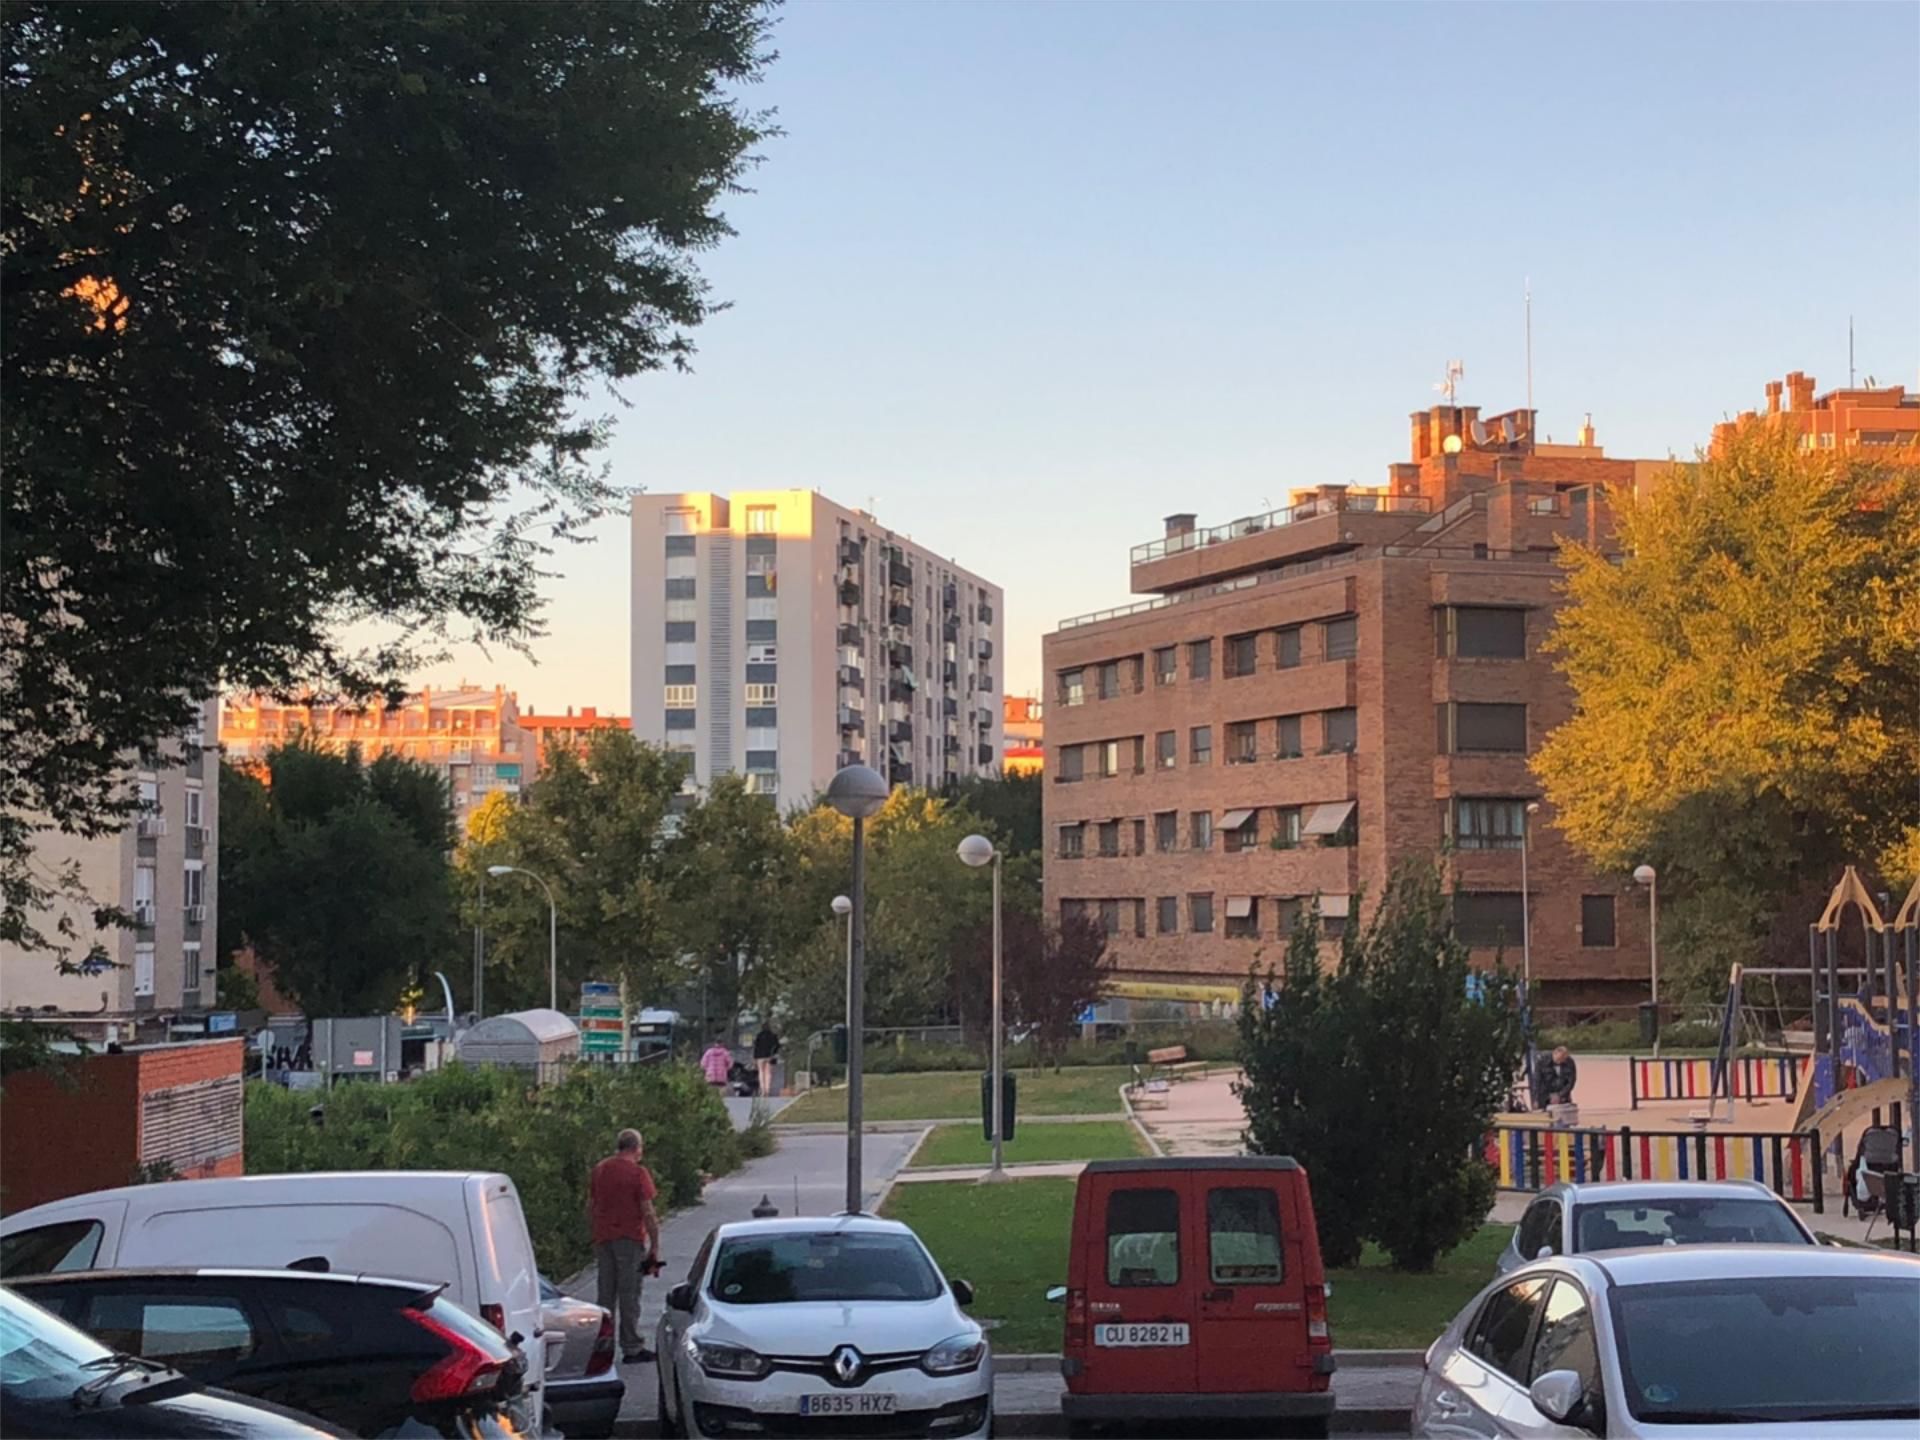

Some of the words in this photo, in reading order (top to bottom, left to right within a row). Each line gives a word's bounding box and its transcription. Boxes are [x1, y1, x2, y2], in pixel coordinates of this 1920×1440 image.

[1106, 1326, 1125, 1342] CU
[1129, 1326, 1168, 1342] 8282
[1173, 1326, 1183, 1342] H
[811, 1395, 853, 1412] 8635
[860, 1395, 892, 1411] HXZ
